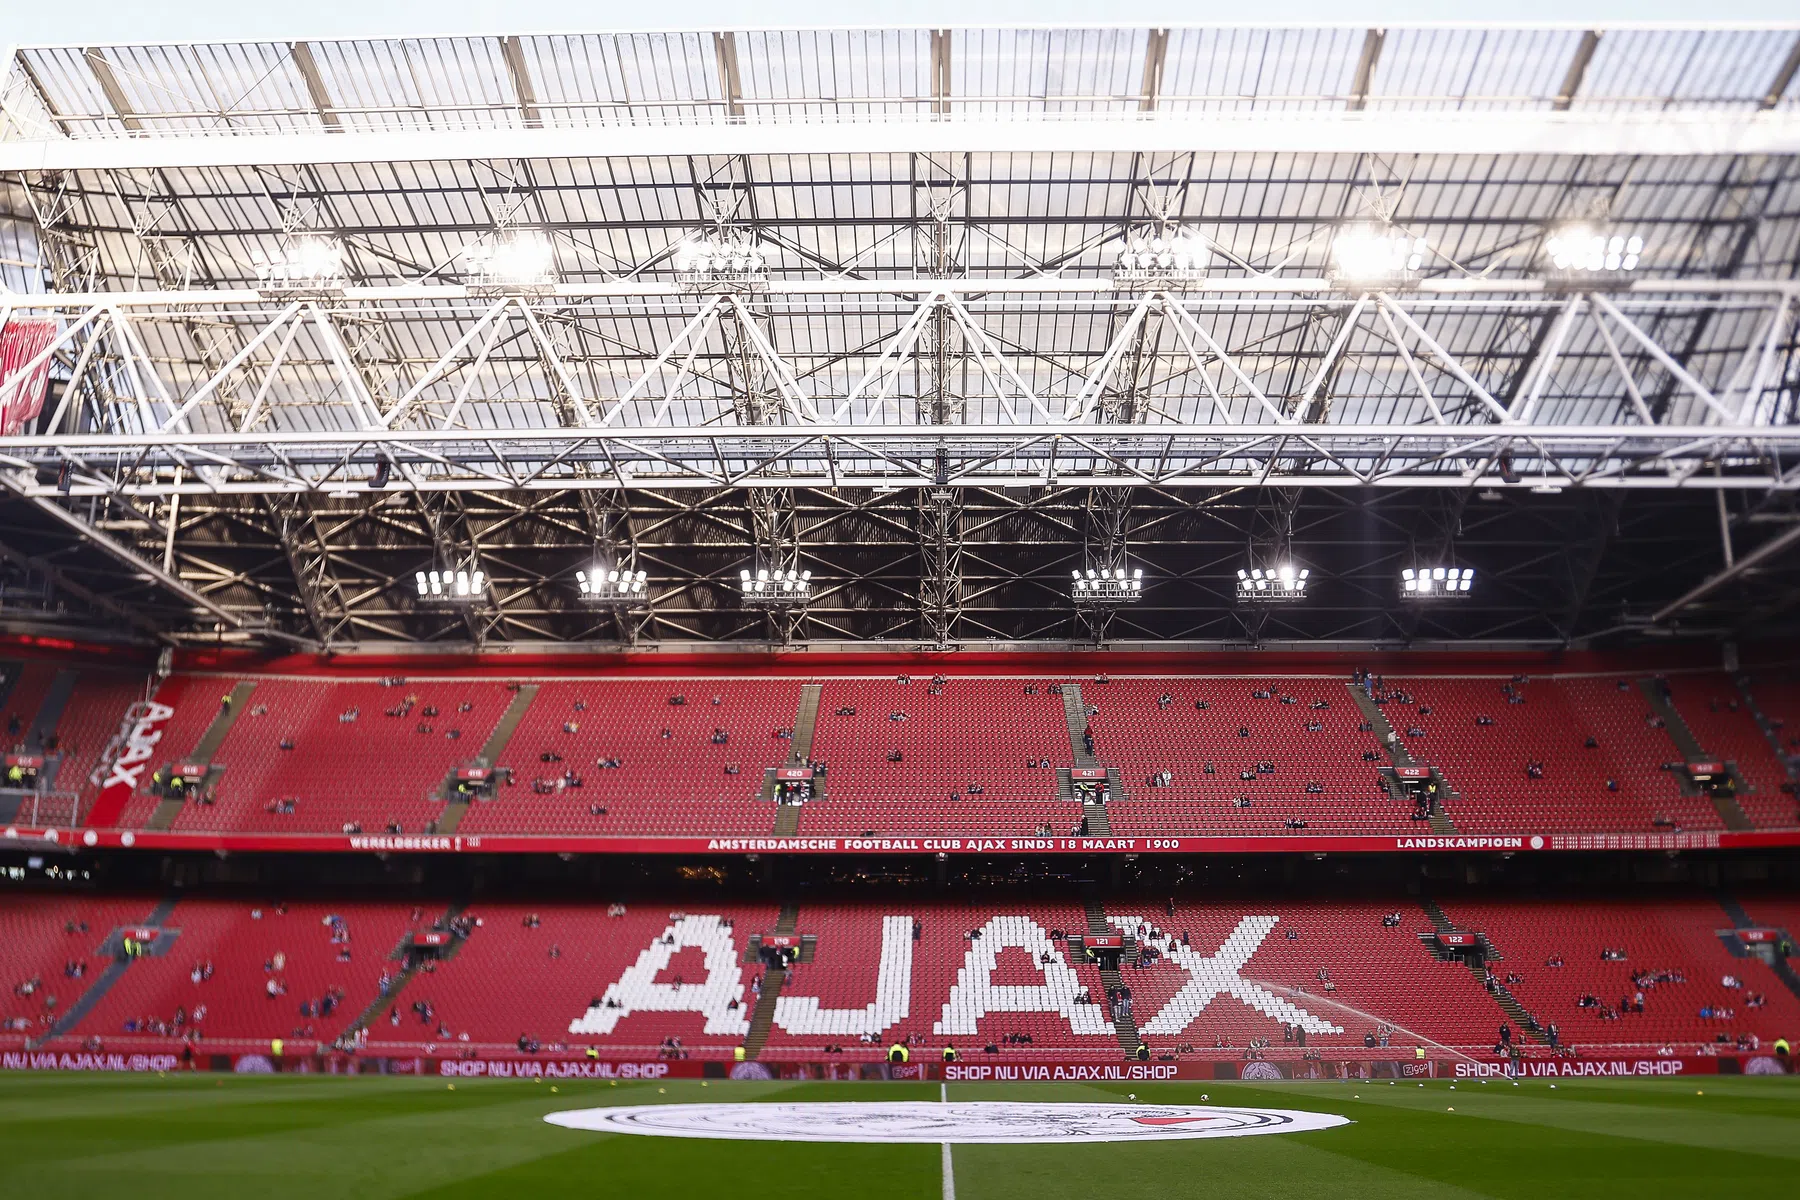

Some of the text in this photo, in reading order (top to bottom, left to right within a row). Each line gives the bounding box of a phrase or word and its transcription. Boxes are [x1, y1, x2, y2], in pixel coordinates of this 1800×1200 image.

[708, 839, 1179, 852] AMSTERDAMSCHE FOOTBALL CLUB AJAX SINDS 18 MAART 1900
[1396, 838, 1522, 848] LANDSKAMPIOEN
[569, 914, 1345, 1036] AJAX
[30, 1053, 58, 1070] VIA
[60, 1053, 177, 1071] AJAX.NL/SHOP
[440, 1060, 669, 1079] SHOP NU VIA AJAX.NL/SHOP
[1455, 1063, 1500, 1077] SHOP
[1530, 1062, 1558, 1077] VIA
[1562, 1060, 1683, 1076] AJAX.NL/SHOP
[945, 1065, 1178, 1080] SHOP NU VIA AJAX.NL/SHOP
